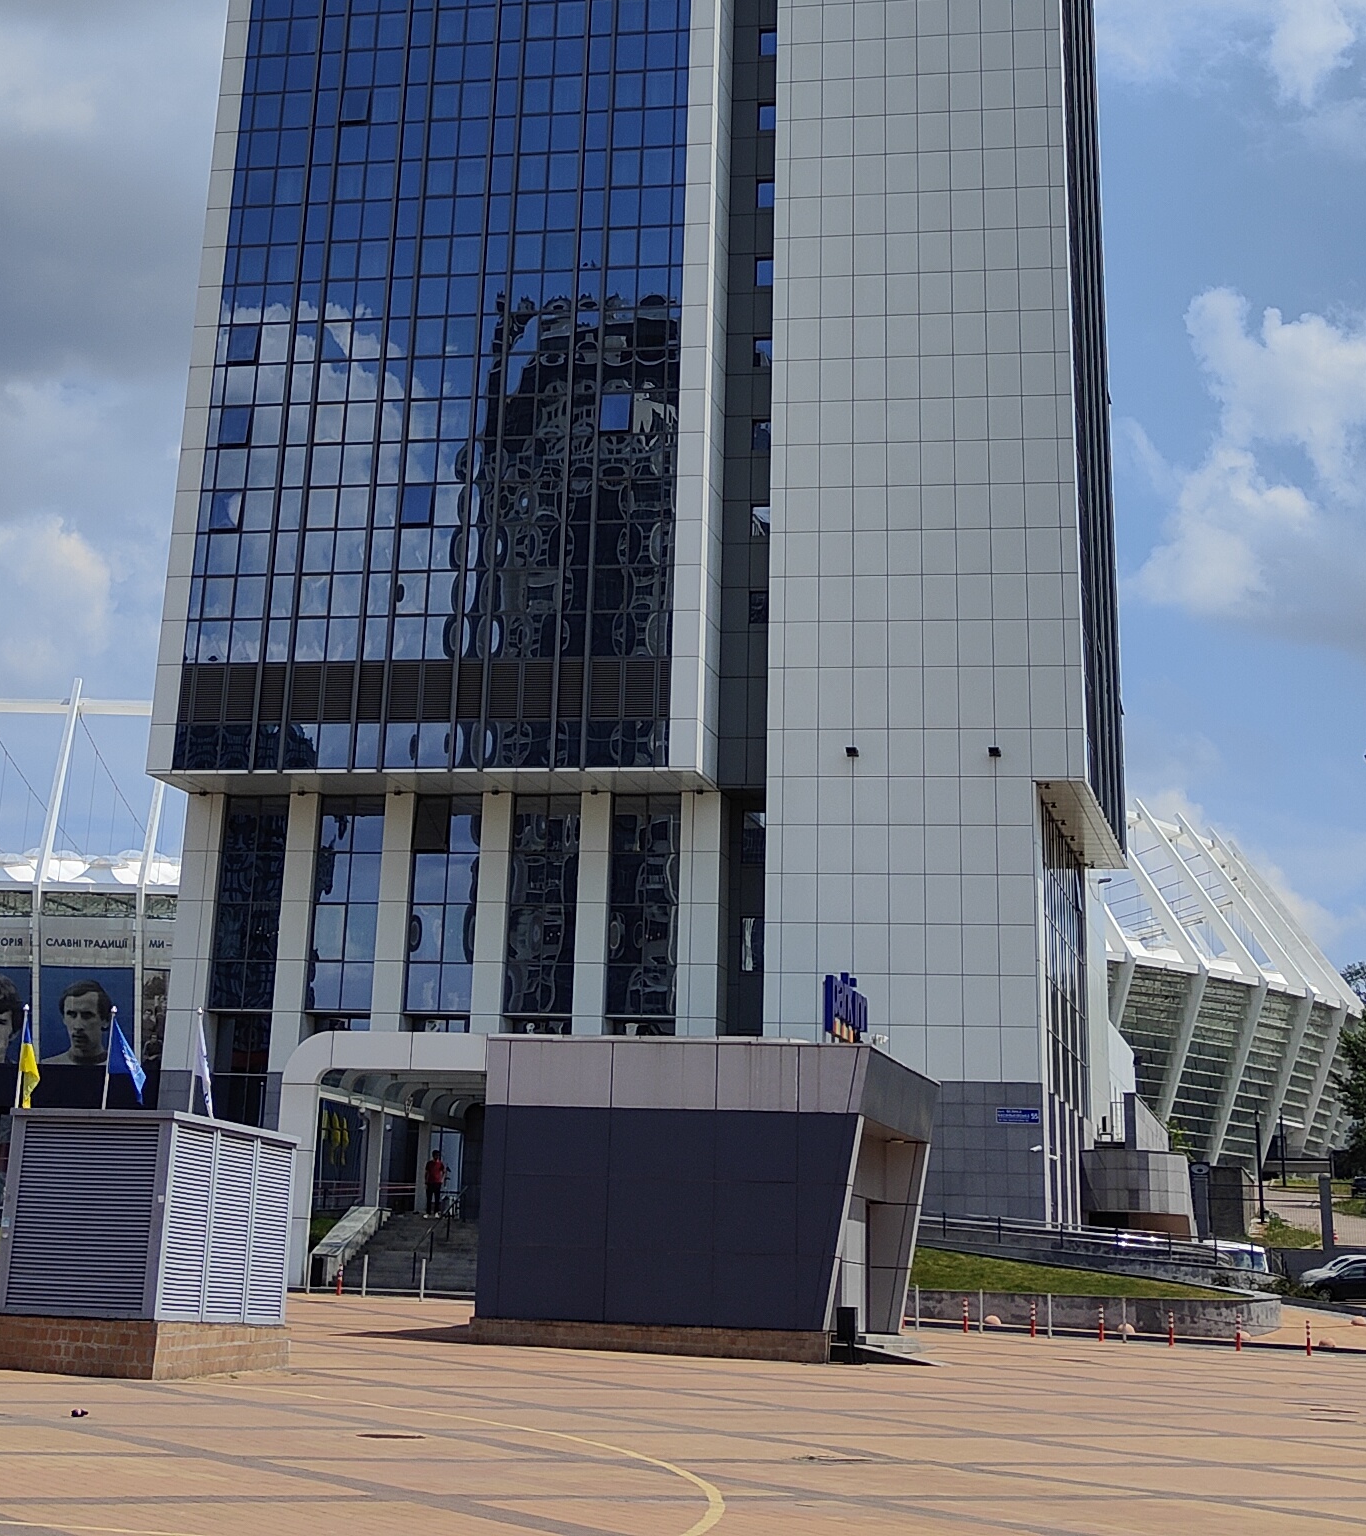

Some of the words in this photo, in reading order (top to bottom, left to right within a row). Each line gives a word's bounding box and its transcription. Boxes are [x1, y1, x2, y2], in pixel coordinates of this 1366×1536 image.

[46, 937, 82, 948] СЛАВНІ
[83, 938, 128, 950] ТРАДИЦІЇ
[825, 972, 853, 1032] park
